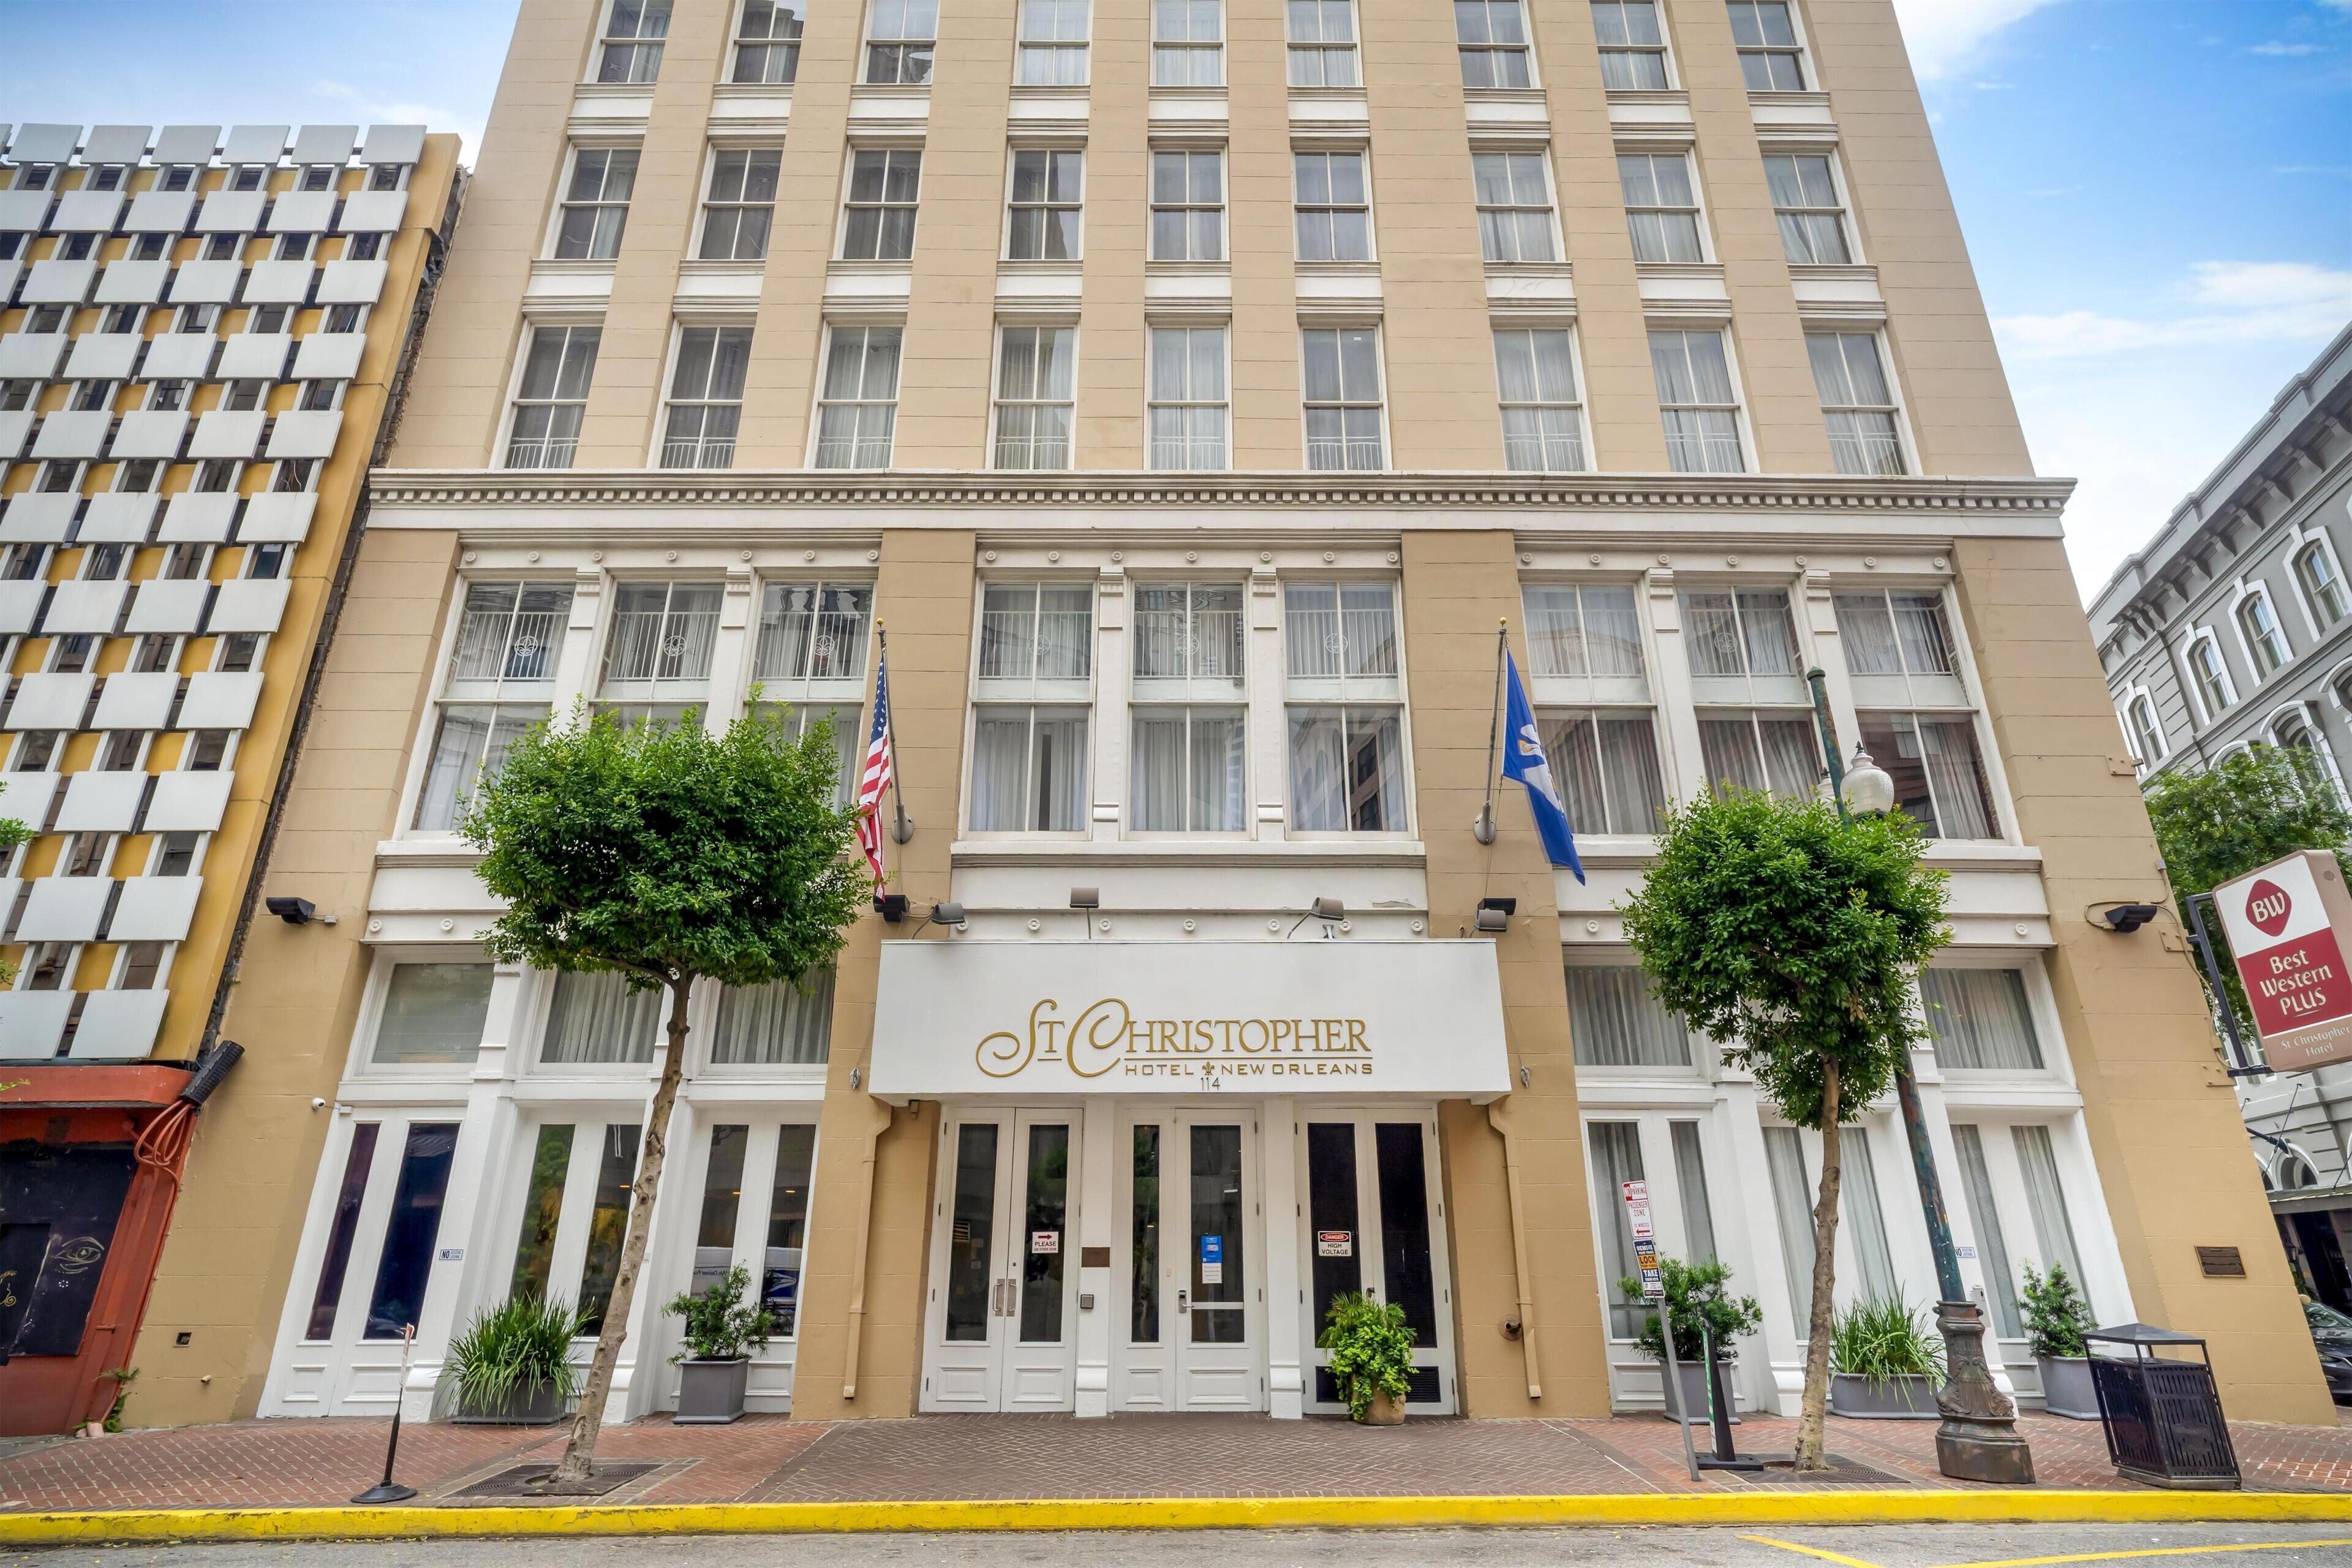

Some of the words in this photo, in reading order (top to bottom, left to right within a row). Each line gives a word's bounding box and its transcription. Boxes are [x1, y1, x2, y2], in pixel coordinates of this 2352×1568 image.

[2252, 892, 2286, 923] BW
[2269, 949, 2309, 974] Best
[2260, 965, 2332, 997] Western
[2279, 987, 2326, 1015] PLUS
[1066, 998, 1372, 1077] CHRISTOPHER
[2294, 1025, 2351, 1046] Christopher
[2305, 1044, 2334, 1057] Hotel
[1125, 1063, 1194, 1076] HOTEL
[1221, 1063, 1264, 1075] NEW
[1272, 1063, 1373, 1075] ORLEANS
[1200, 1077, 1221, 1091] 114
[1623, 1186, 1631, 1197] NO
[1639, 1255, 1656, 1264] LOCK
[1643, 1269, 1659, 1278] TAKE
